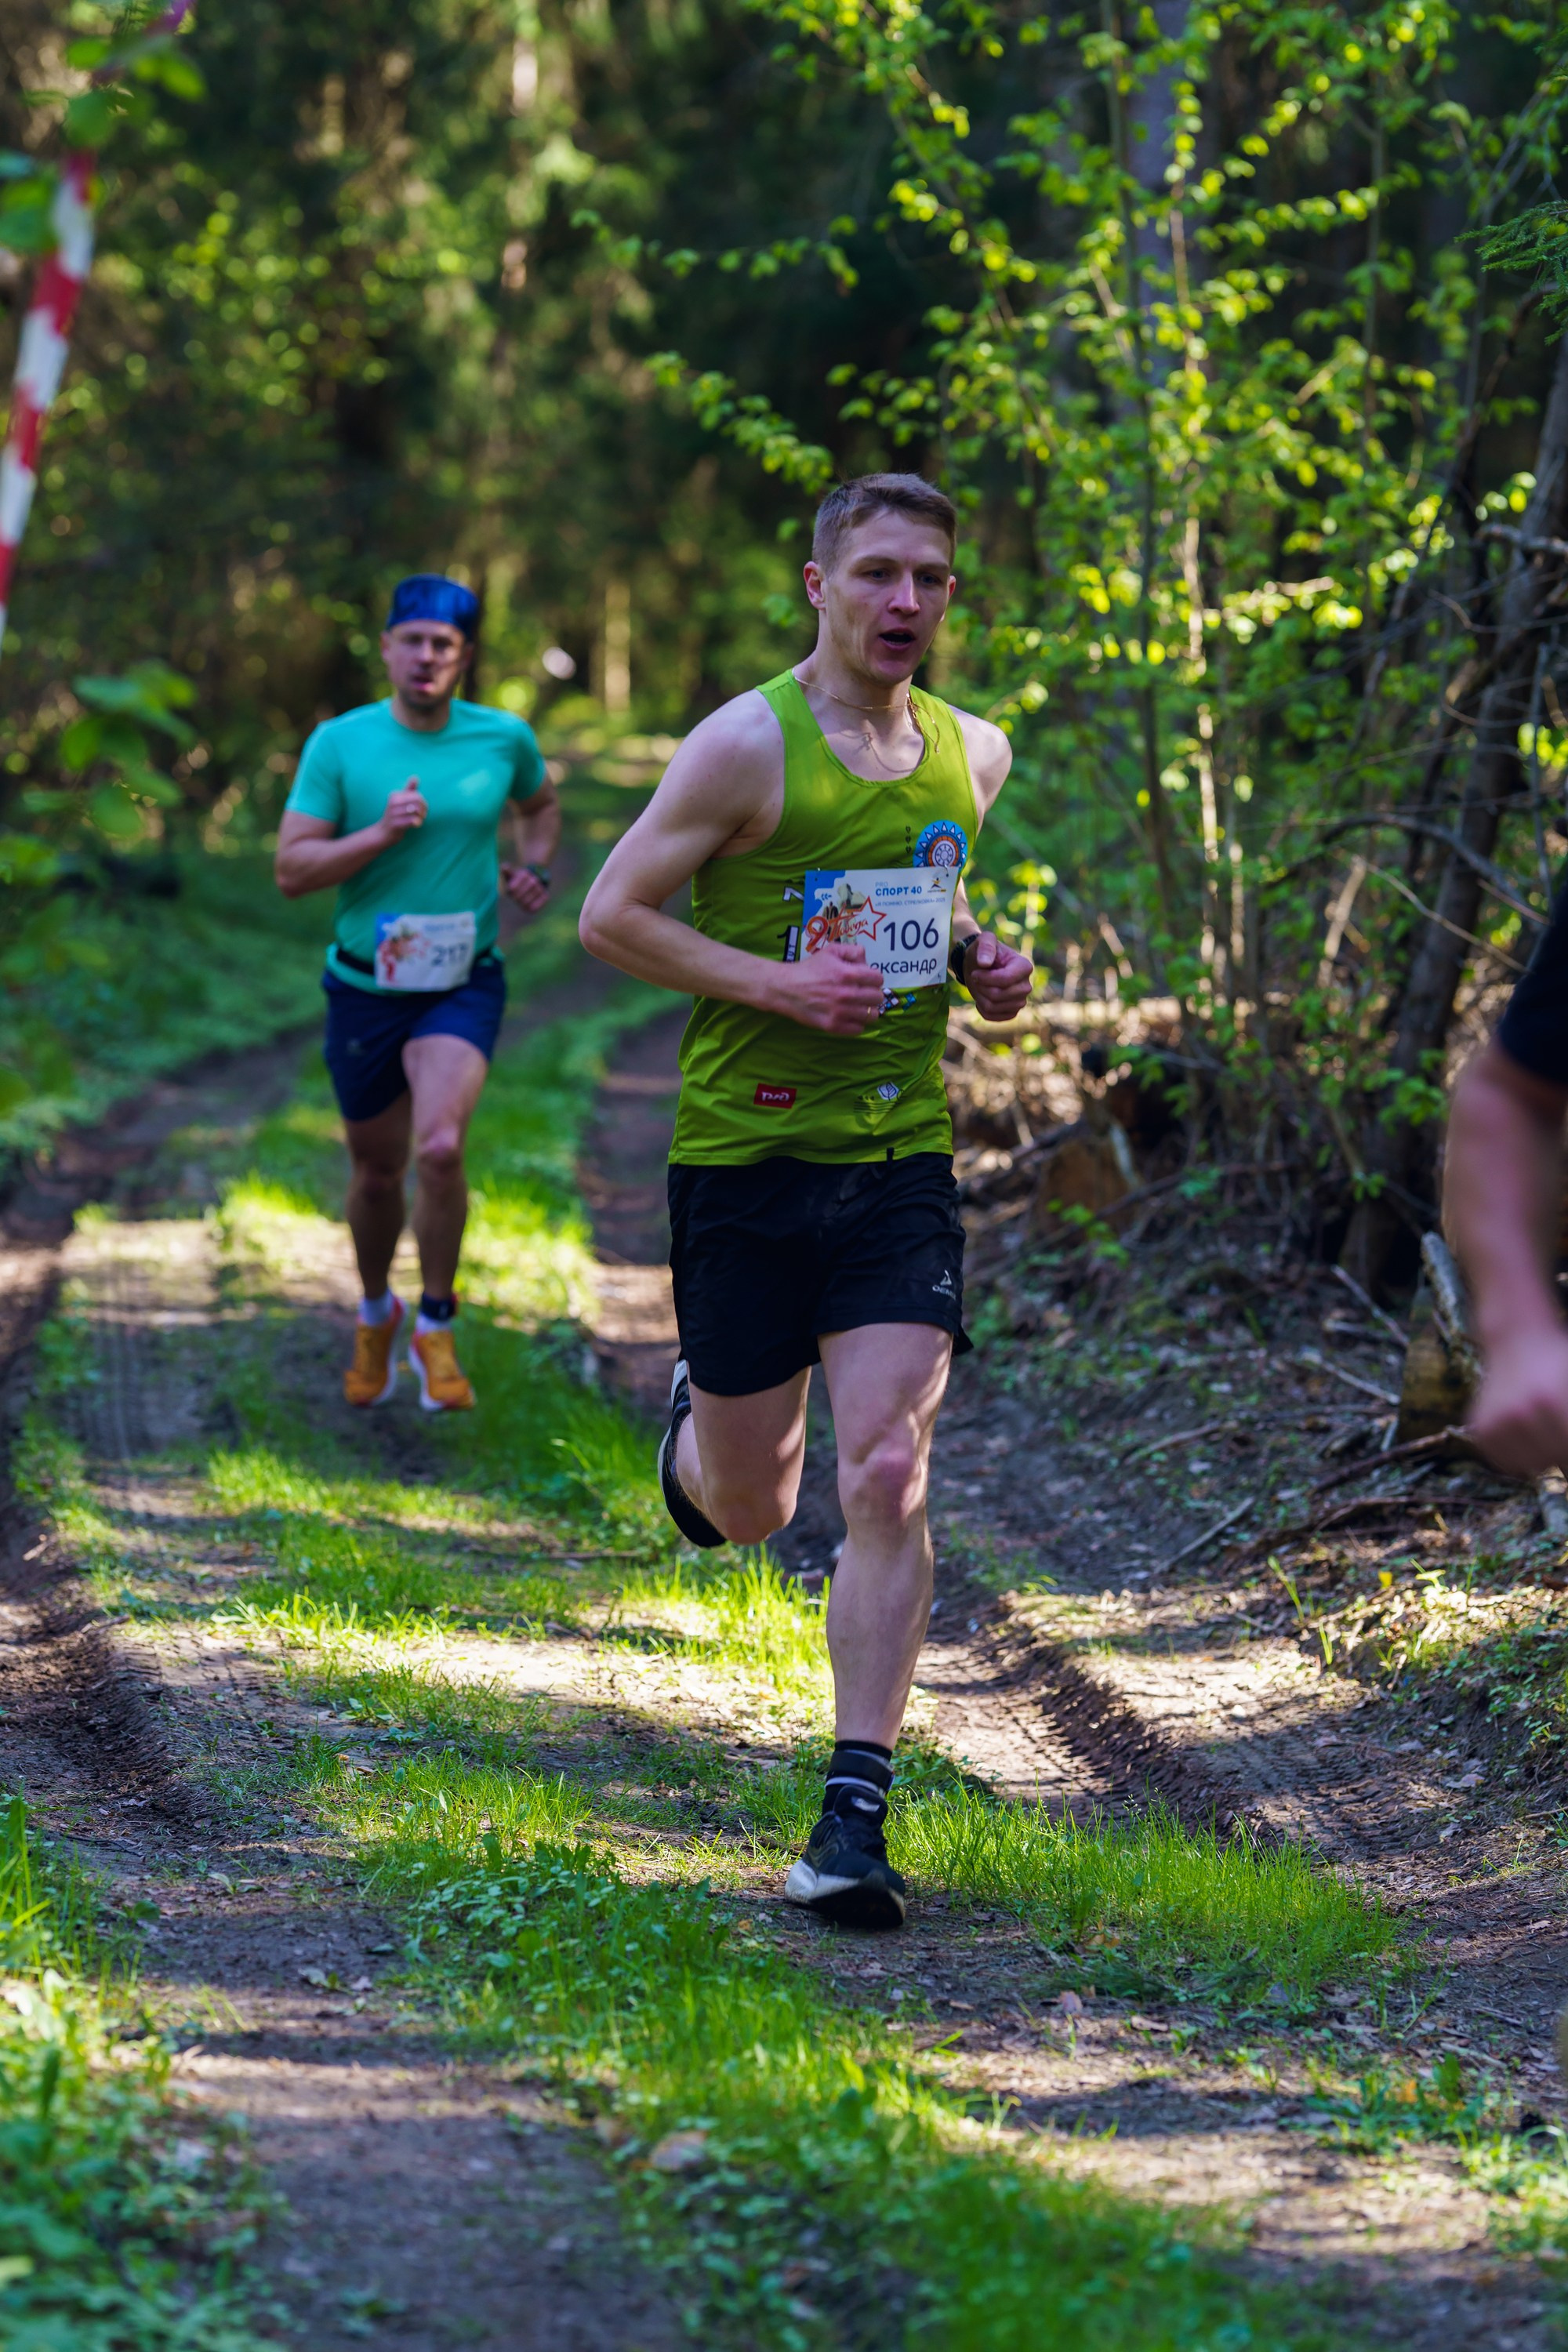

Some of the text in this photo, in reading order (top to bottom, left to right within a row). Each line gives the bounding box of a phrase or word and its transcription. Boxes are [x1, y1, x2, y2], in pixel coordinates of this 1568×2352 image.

[875, 887, 909, 896] СПОРТ
[910, 886, 922, 895] 40
[883, 917, 939, 951] 106
[869, 958, 937, 975] ександр
